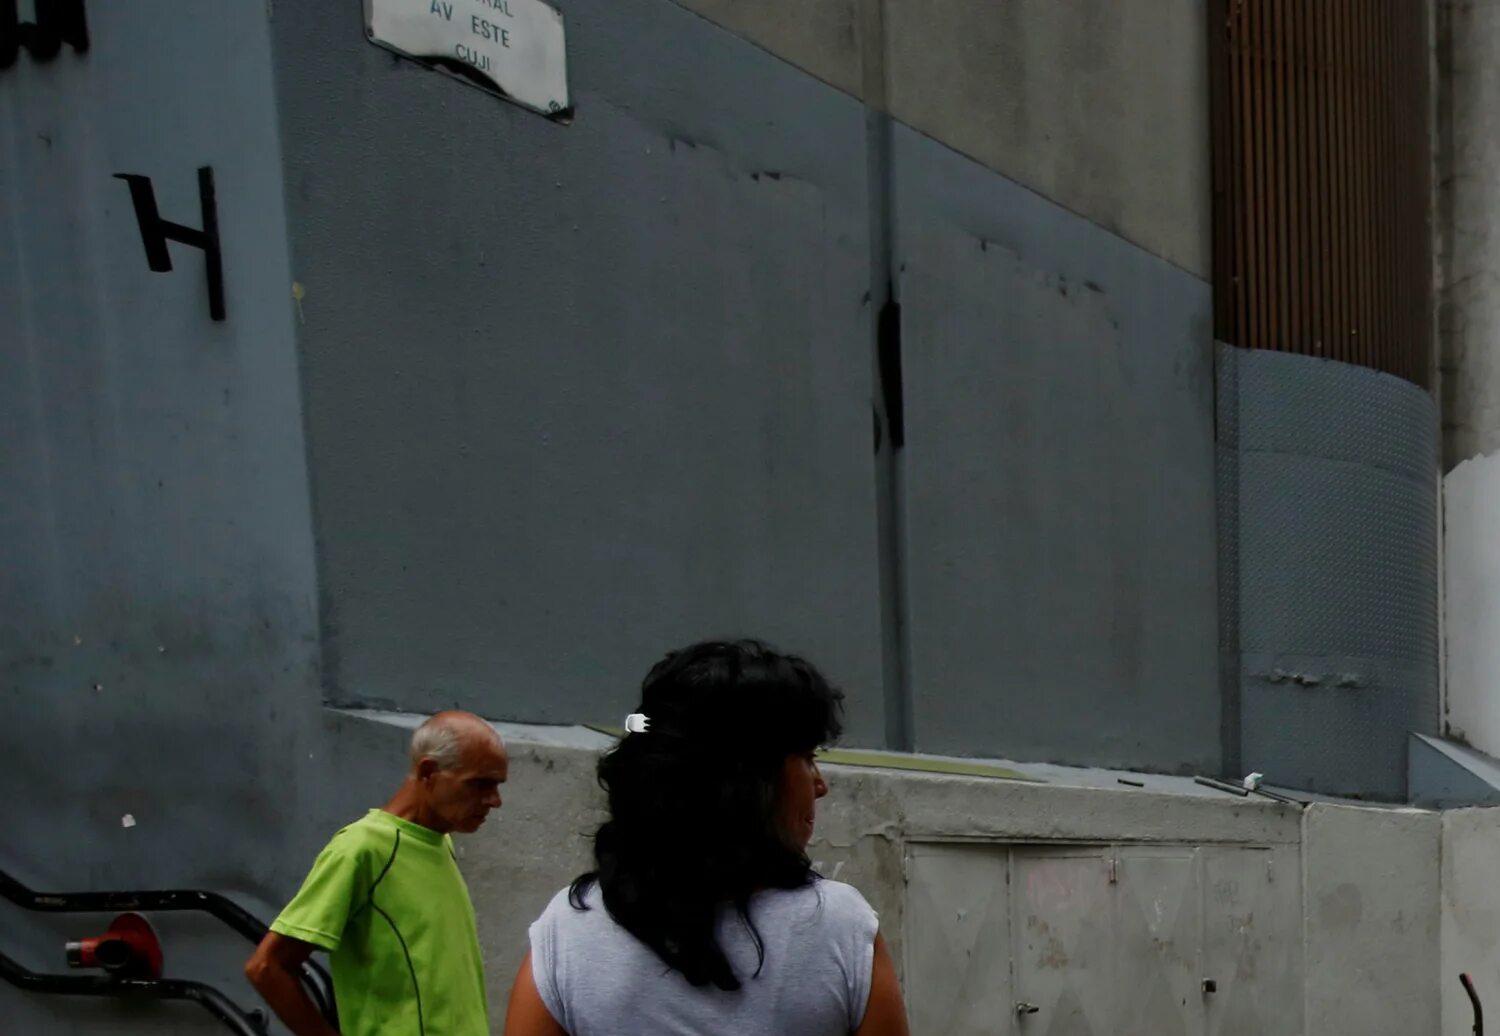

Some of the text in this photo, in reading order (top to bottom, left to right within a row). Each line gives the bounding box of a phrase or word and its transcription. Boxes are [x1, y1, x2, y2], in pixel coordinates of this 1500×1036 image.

[431, 0, 510, 48] AV ESTE
[456, 43, 490, 71] CUJI
